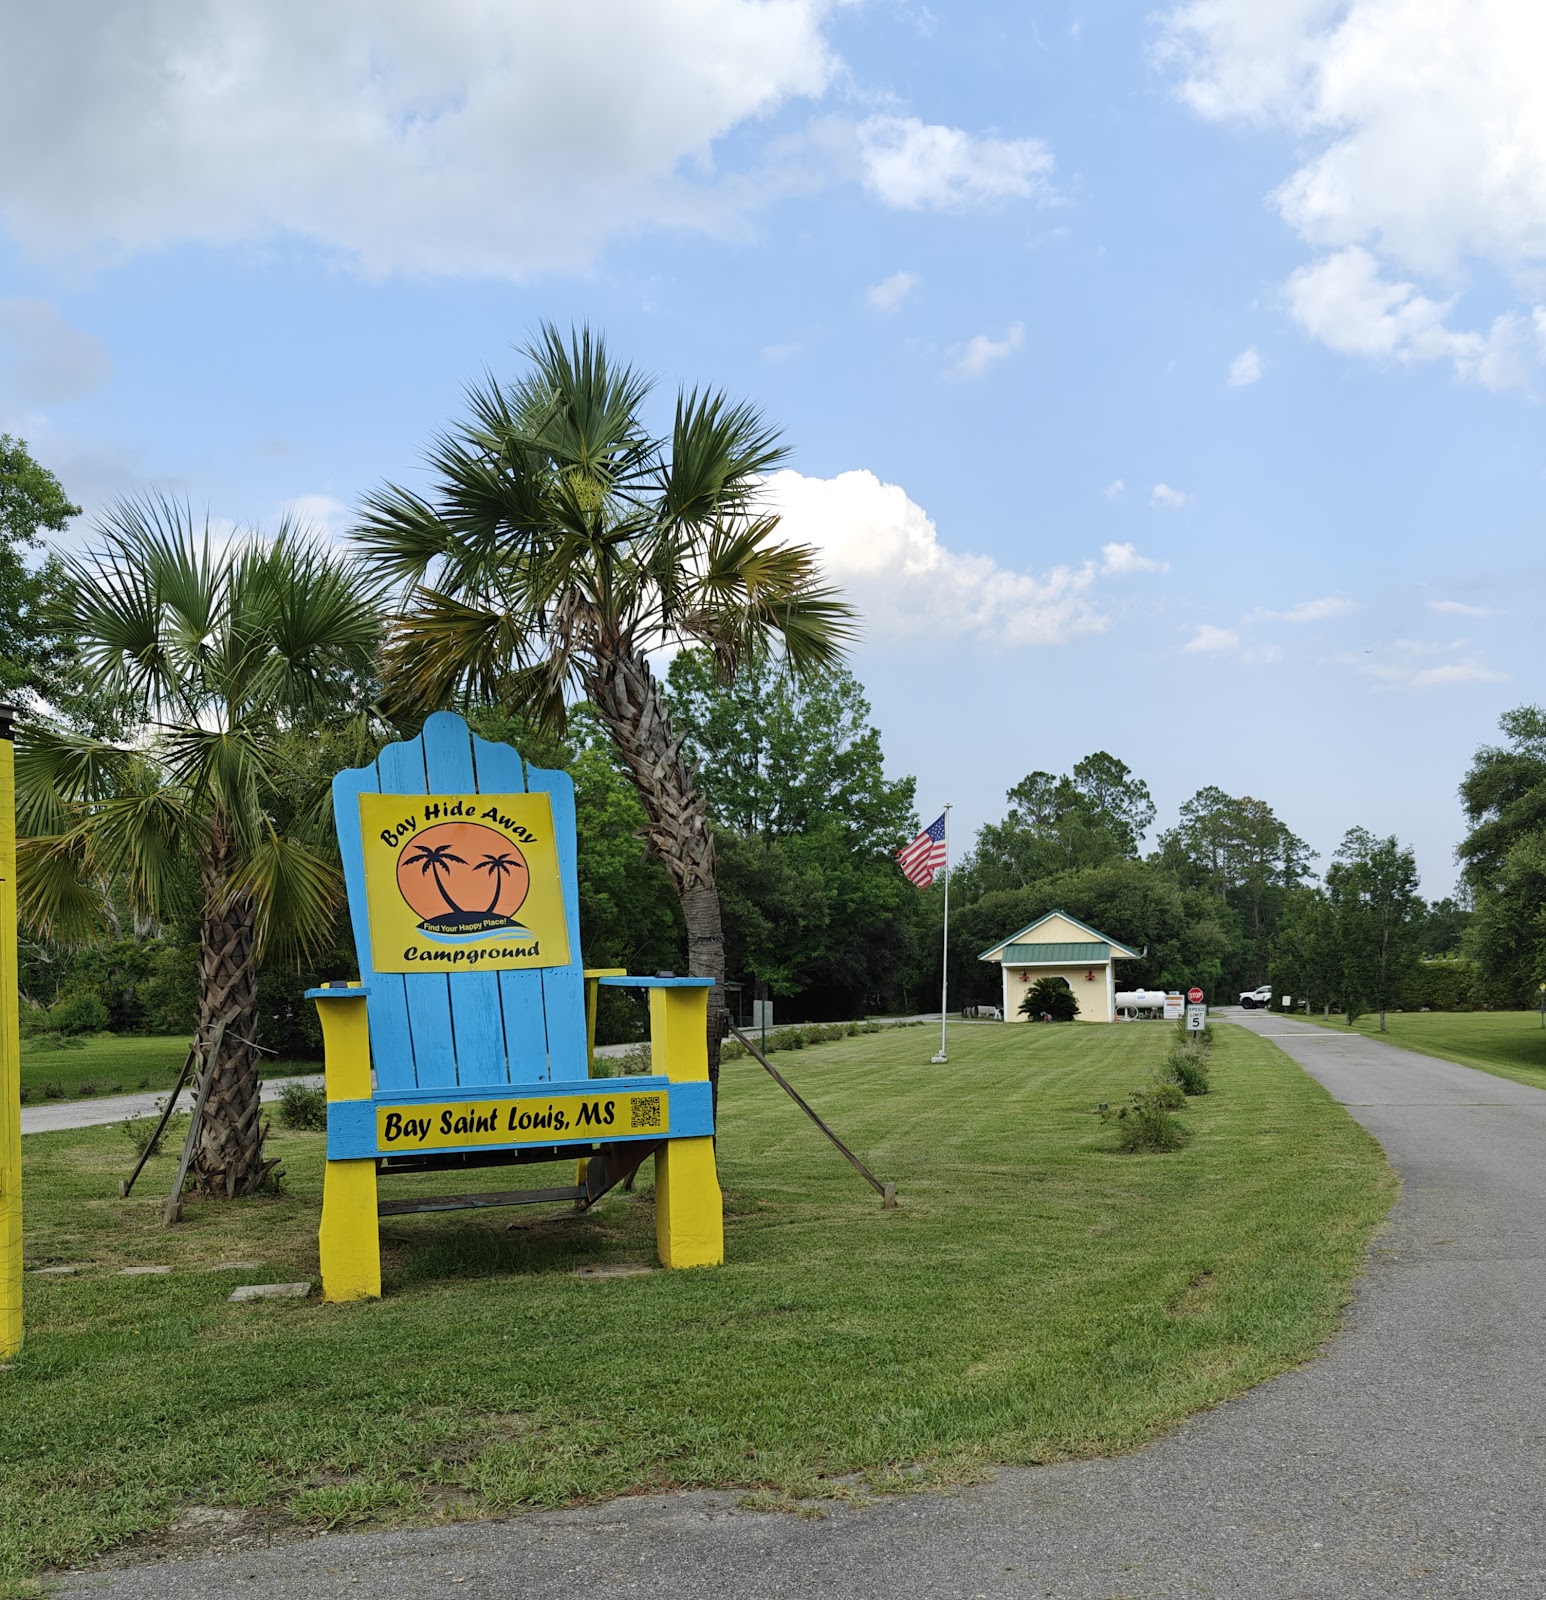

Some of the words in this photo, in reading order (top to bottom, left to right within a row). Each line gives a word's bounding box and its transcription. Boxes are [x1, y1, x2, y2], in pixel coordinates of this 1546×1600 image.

[380, 815, 417, 848] Bay
[424, 800, 476, 821] Hide
[480, 806, 538, 844] Away
[423, 922, 440, 932] Find
[441, 924, 458, 933] Your
[459, 922, 482, 933] Happy
[483, 918, 507, 928] Place!
[403, 941, 540, 964] Campground
[1192, 1018, 1200, 1027] 5
[384, 1112, 432, 1142] Bay
[439, 1108, 498, 1135] Saint
[507, 1104, 570, 1132] Louis,
[575, 1100, 616, 1127] MS
